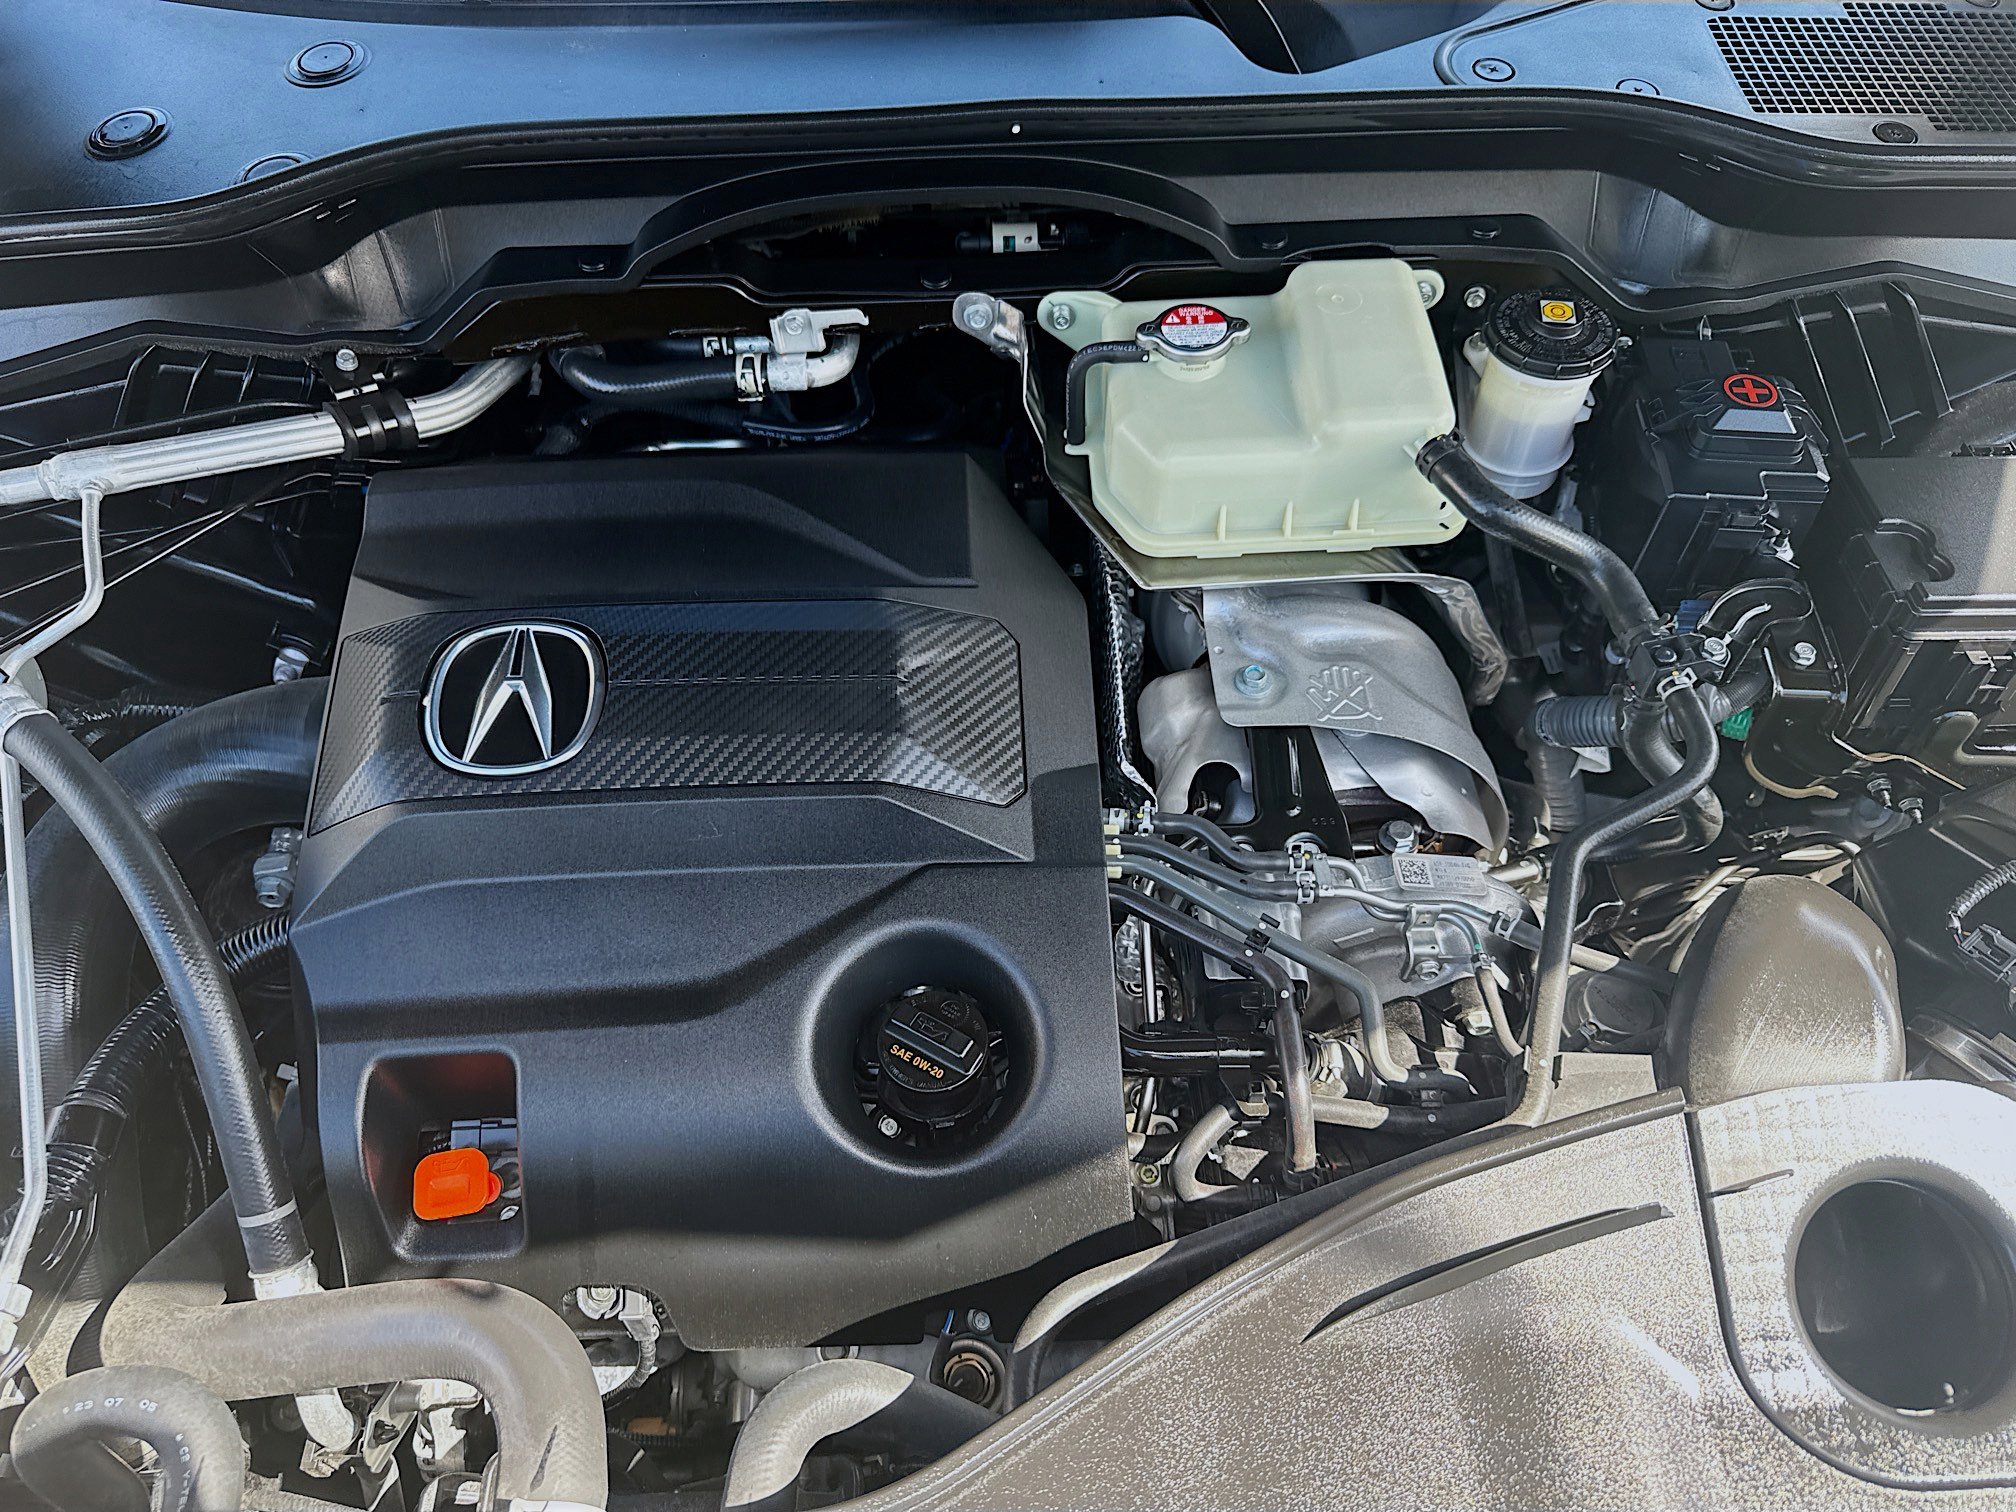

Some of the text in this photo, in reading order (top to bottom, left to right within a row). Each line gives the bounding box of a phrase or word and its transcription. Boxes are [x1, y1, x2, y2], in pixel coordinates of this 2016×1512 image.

[890, 1044, 913, 1062] SAE
[912, 1056, 944, 1079] 0W-20
[74, 1397, 158, 1413] 23 07 05
